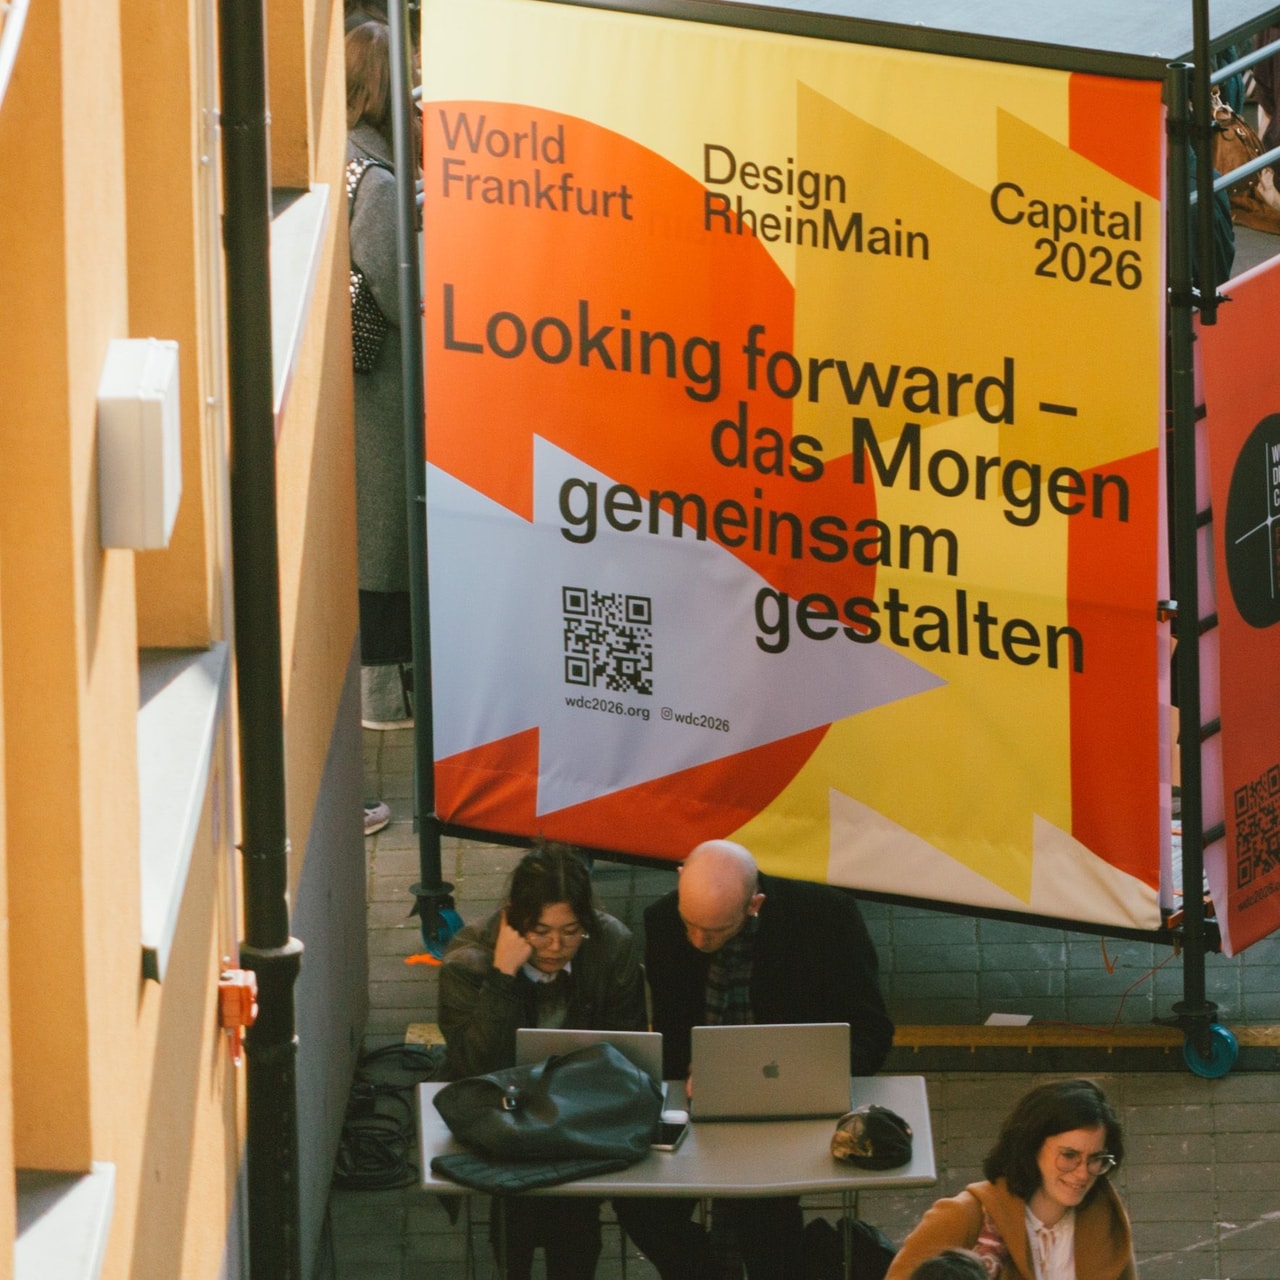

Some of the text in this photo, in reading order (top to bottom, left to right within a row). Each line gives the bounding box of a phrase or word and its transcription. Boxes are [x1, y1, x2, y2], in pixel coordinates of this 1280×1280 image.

[439, 108, 566, 165] World
[441, 157, 634, 221] Frankfurt
[703, 143, 847, 210] Design
[703, 190, 930, 261] RheinMain
[990, 181, 1143, 243] Capital
[1034, 237, 1143, 291] 2026
[444, 283, 721, 403] Looking
[743, 324, 1015, 426] forward
[710, 401, 1130, 527] das Morgen
[558, 477, 959, 577] gemeinsam
[755, 586, 1085, 675] gestalten
[565, 695, 731, 733] wdc2026.org wdc2026
